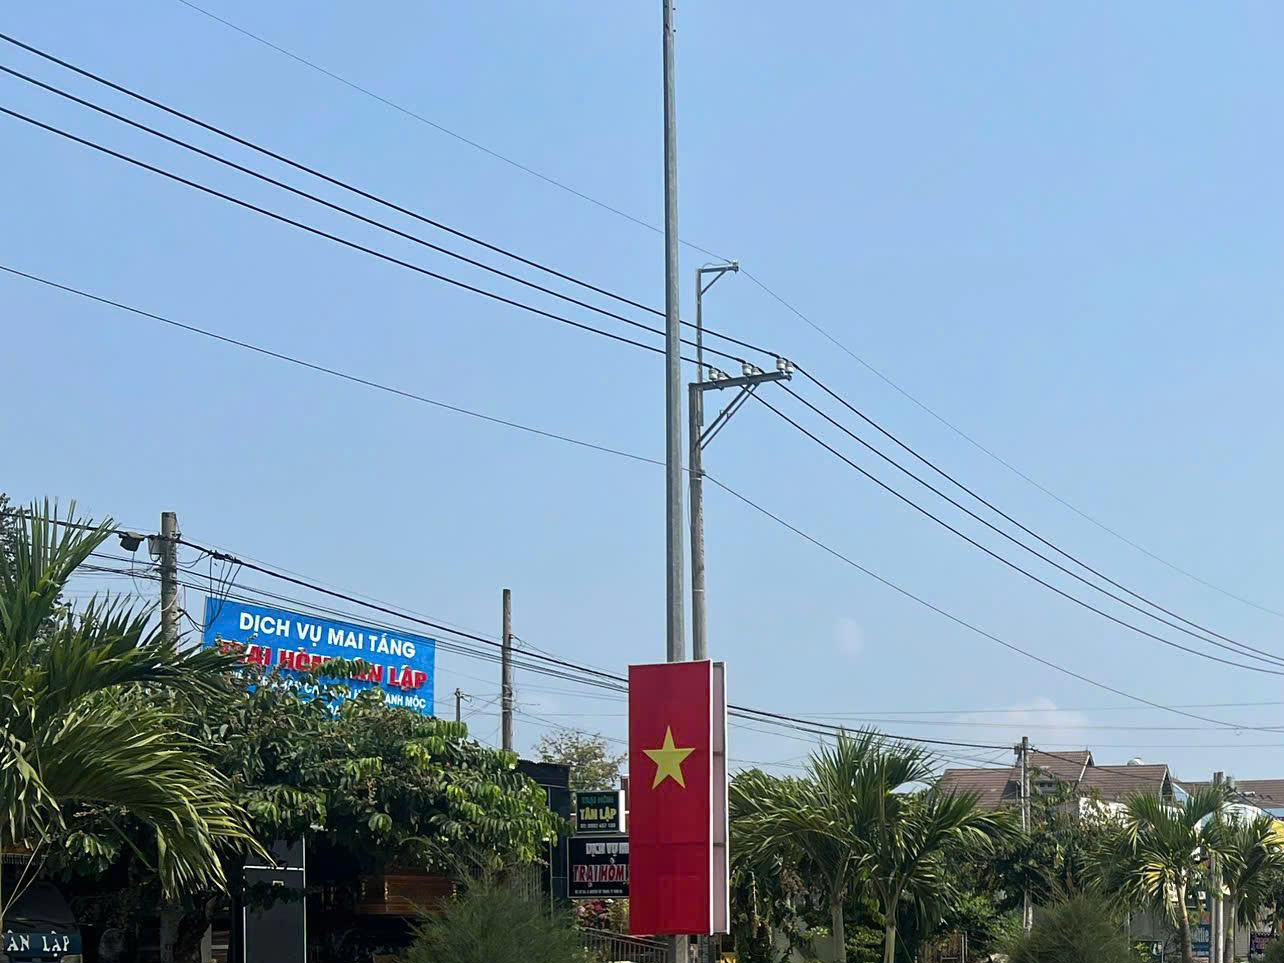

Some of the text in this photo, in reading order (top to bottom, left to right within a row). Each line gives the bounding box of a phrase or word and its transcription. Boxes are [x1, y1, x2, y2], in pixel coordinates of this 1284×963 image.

[239, 611, 416, 659] DỊCH VỤ MAI TÁNG
[387, 664, 428, 691] LẬP
[599, 806, 617, 822] LẬP
[6, 929, 30, 951] ÂN
